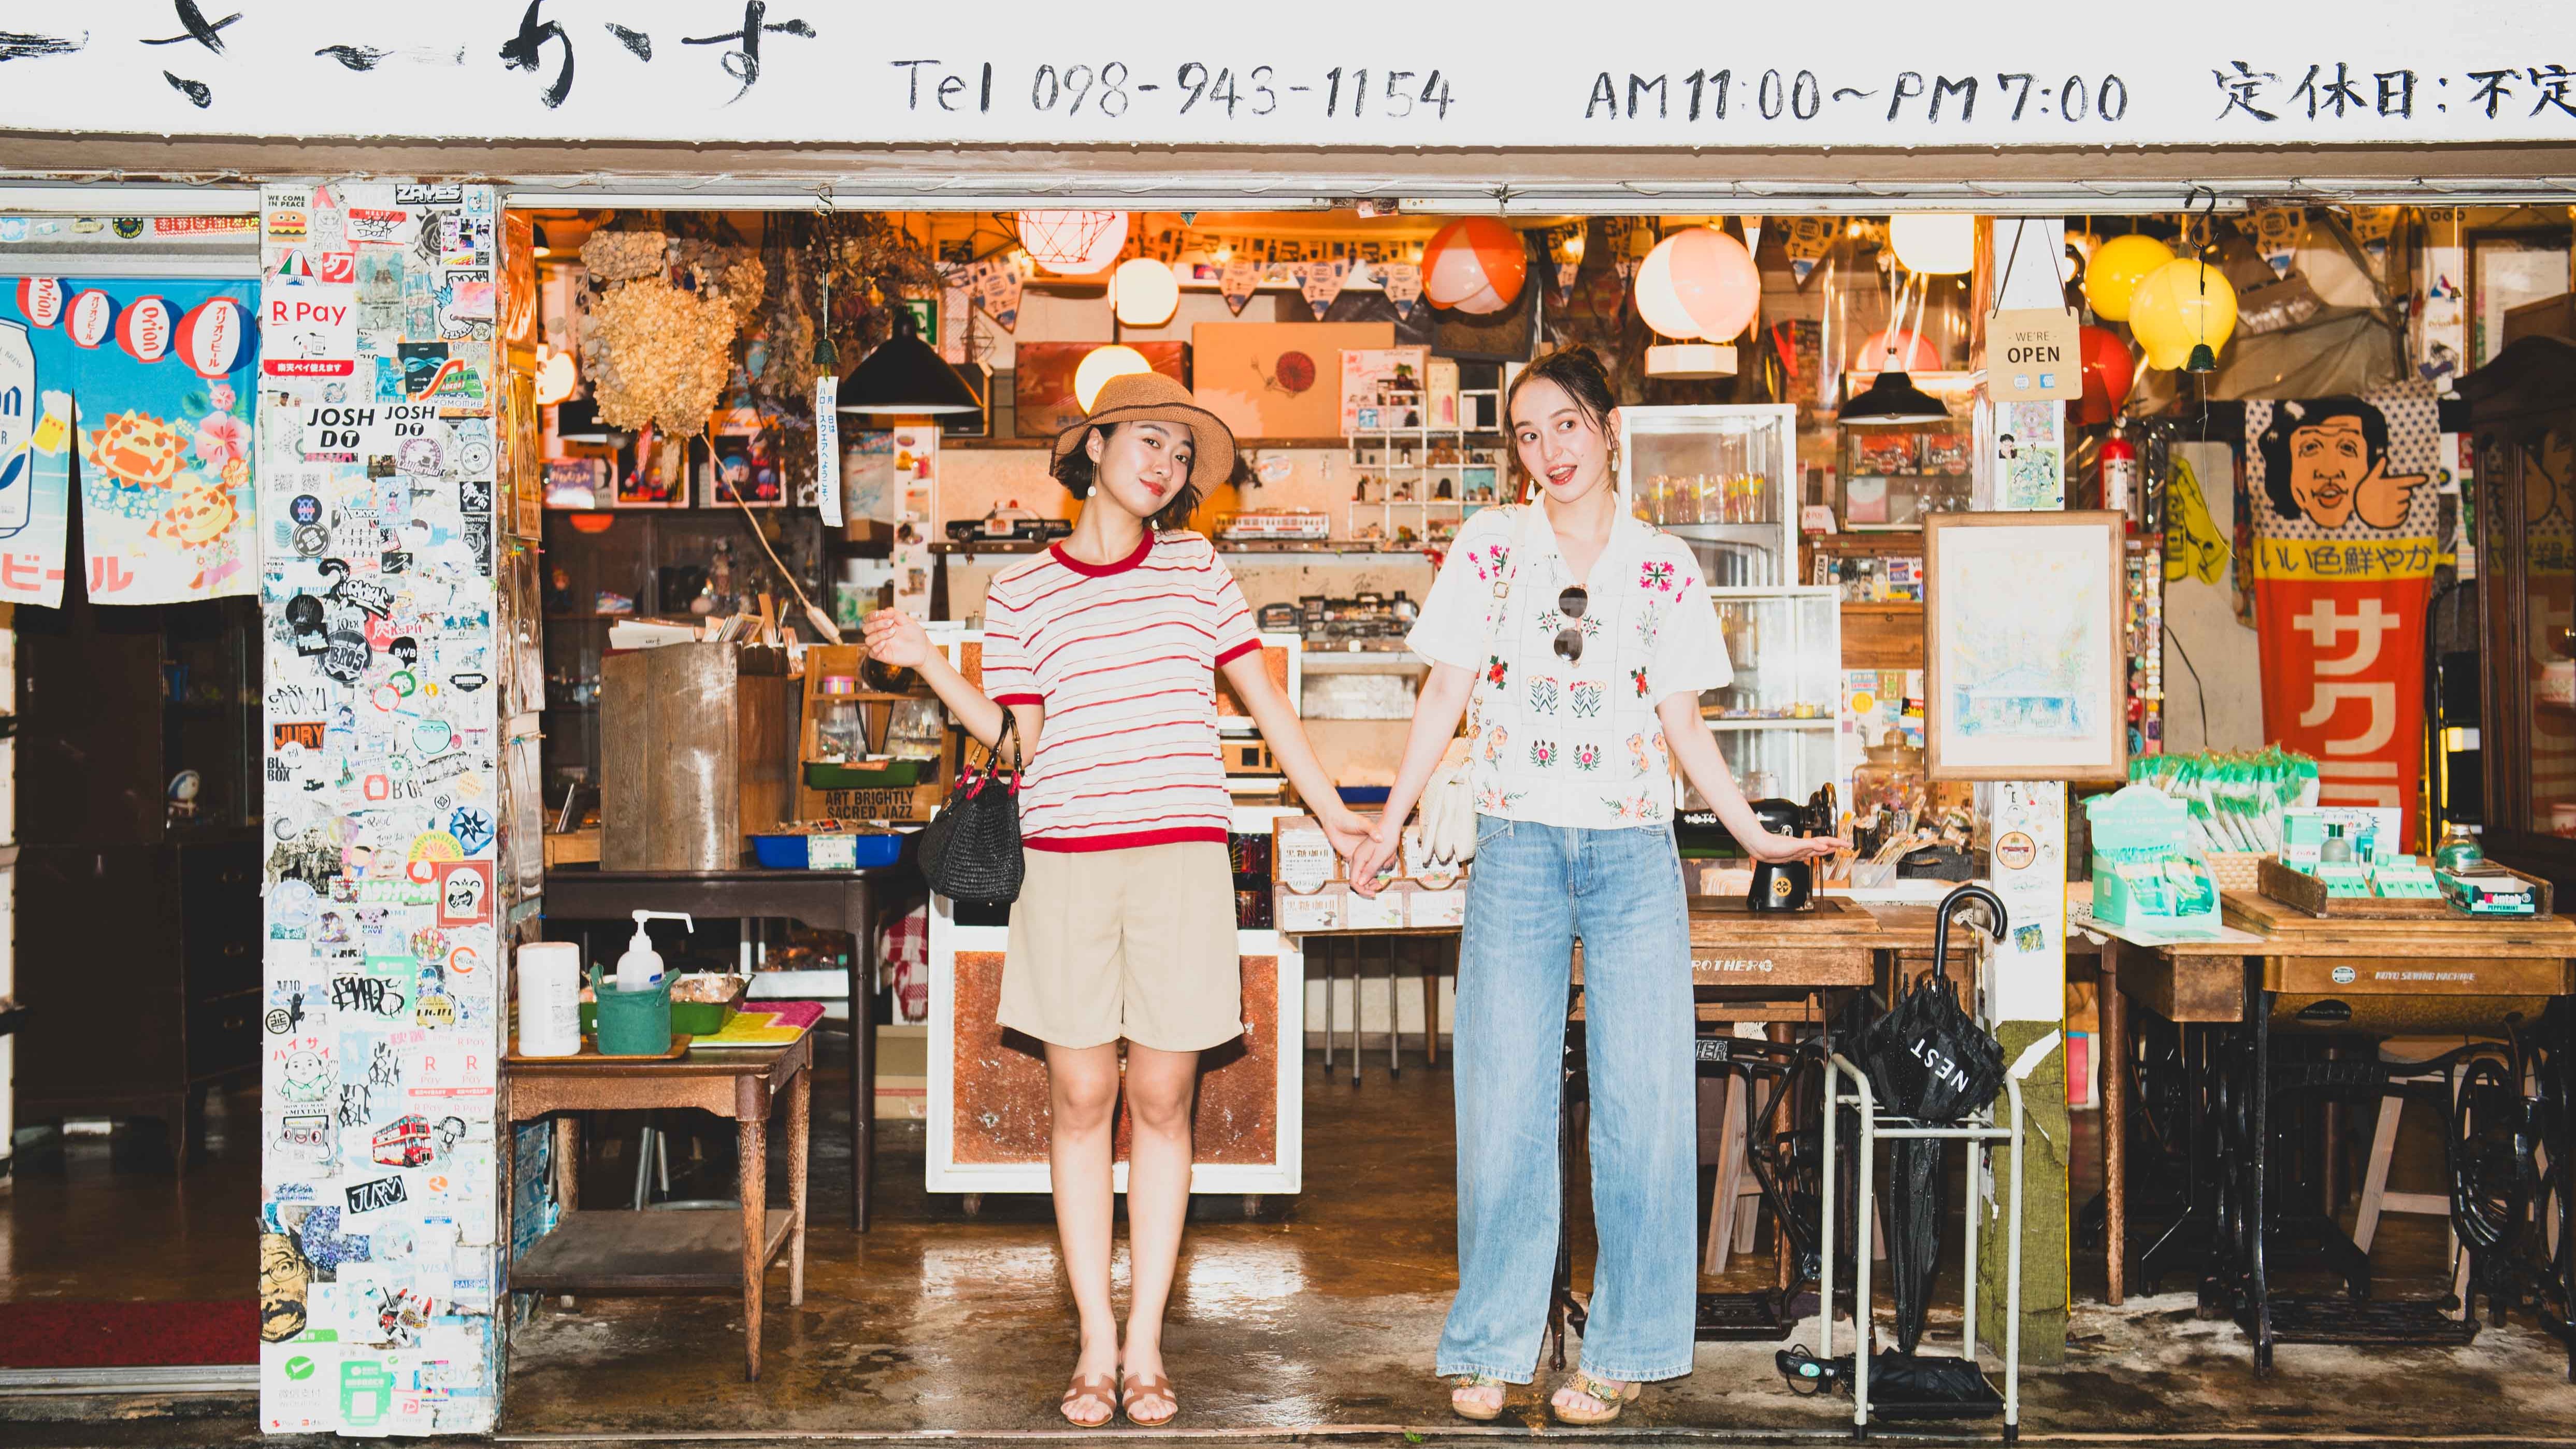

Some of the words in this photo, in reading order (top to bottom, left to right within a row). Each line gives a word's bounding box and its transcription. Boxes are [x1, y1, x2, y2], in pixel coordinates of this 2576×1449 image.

[889, 60, 992, 114] Tel
[1032, 61, 1455, 120] 098-943-1154
[271, 300, 289, 326] R
[296, 302, 347, 326] Pay
[208, 306, 229, 368] オリオンビール
[2015, 331, 2050, 342] WE'RE
[2007, 346, 2061, 364] OPEN
[307, 408, 375, 426] JOSH
[385, 406, 435, 420] JOSH
[397, 460, 440, 477] California
[2260, 544, 2433, 577] いい色鮮やか
[330, 647, 365, 671] BROS
[275, 725, 325, 747] JURY
[267, 769, 290, 782] BOX
[826, 792, 850, 806] ART
[855, 791, 914, 806] BRIGHTLY
[827, 805, 877, 820] SACRED
[881, 805, 913, 819] JAZZ
[1691, 959, 1760, 972] ROTHER
[2400, 972, 2435, 981] SEWING
[2436, 972, 2476, 981] MACHINE
[274, 1037, 330, 1061] ハイサイ
[1909, 1037, 1969, 1093] NEST
